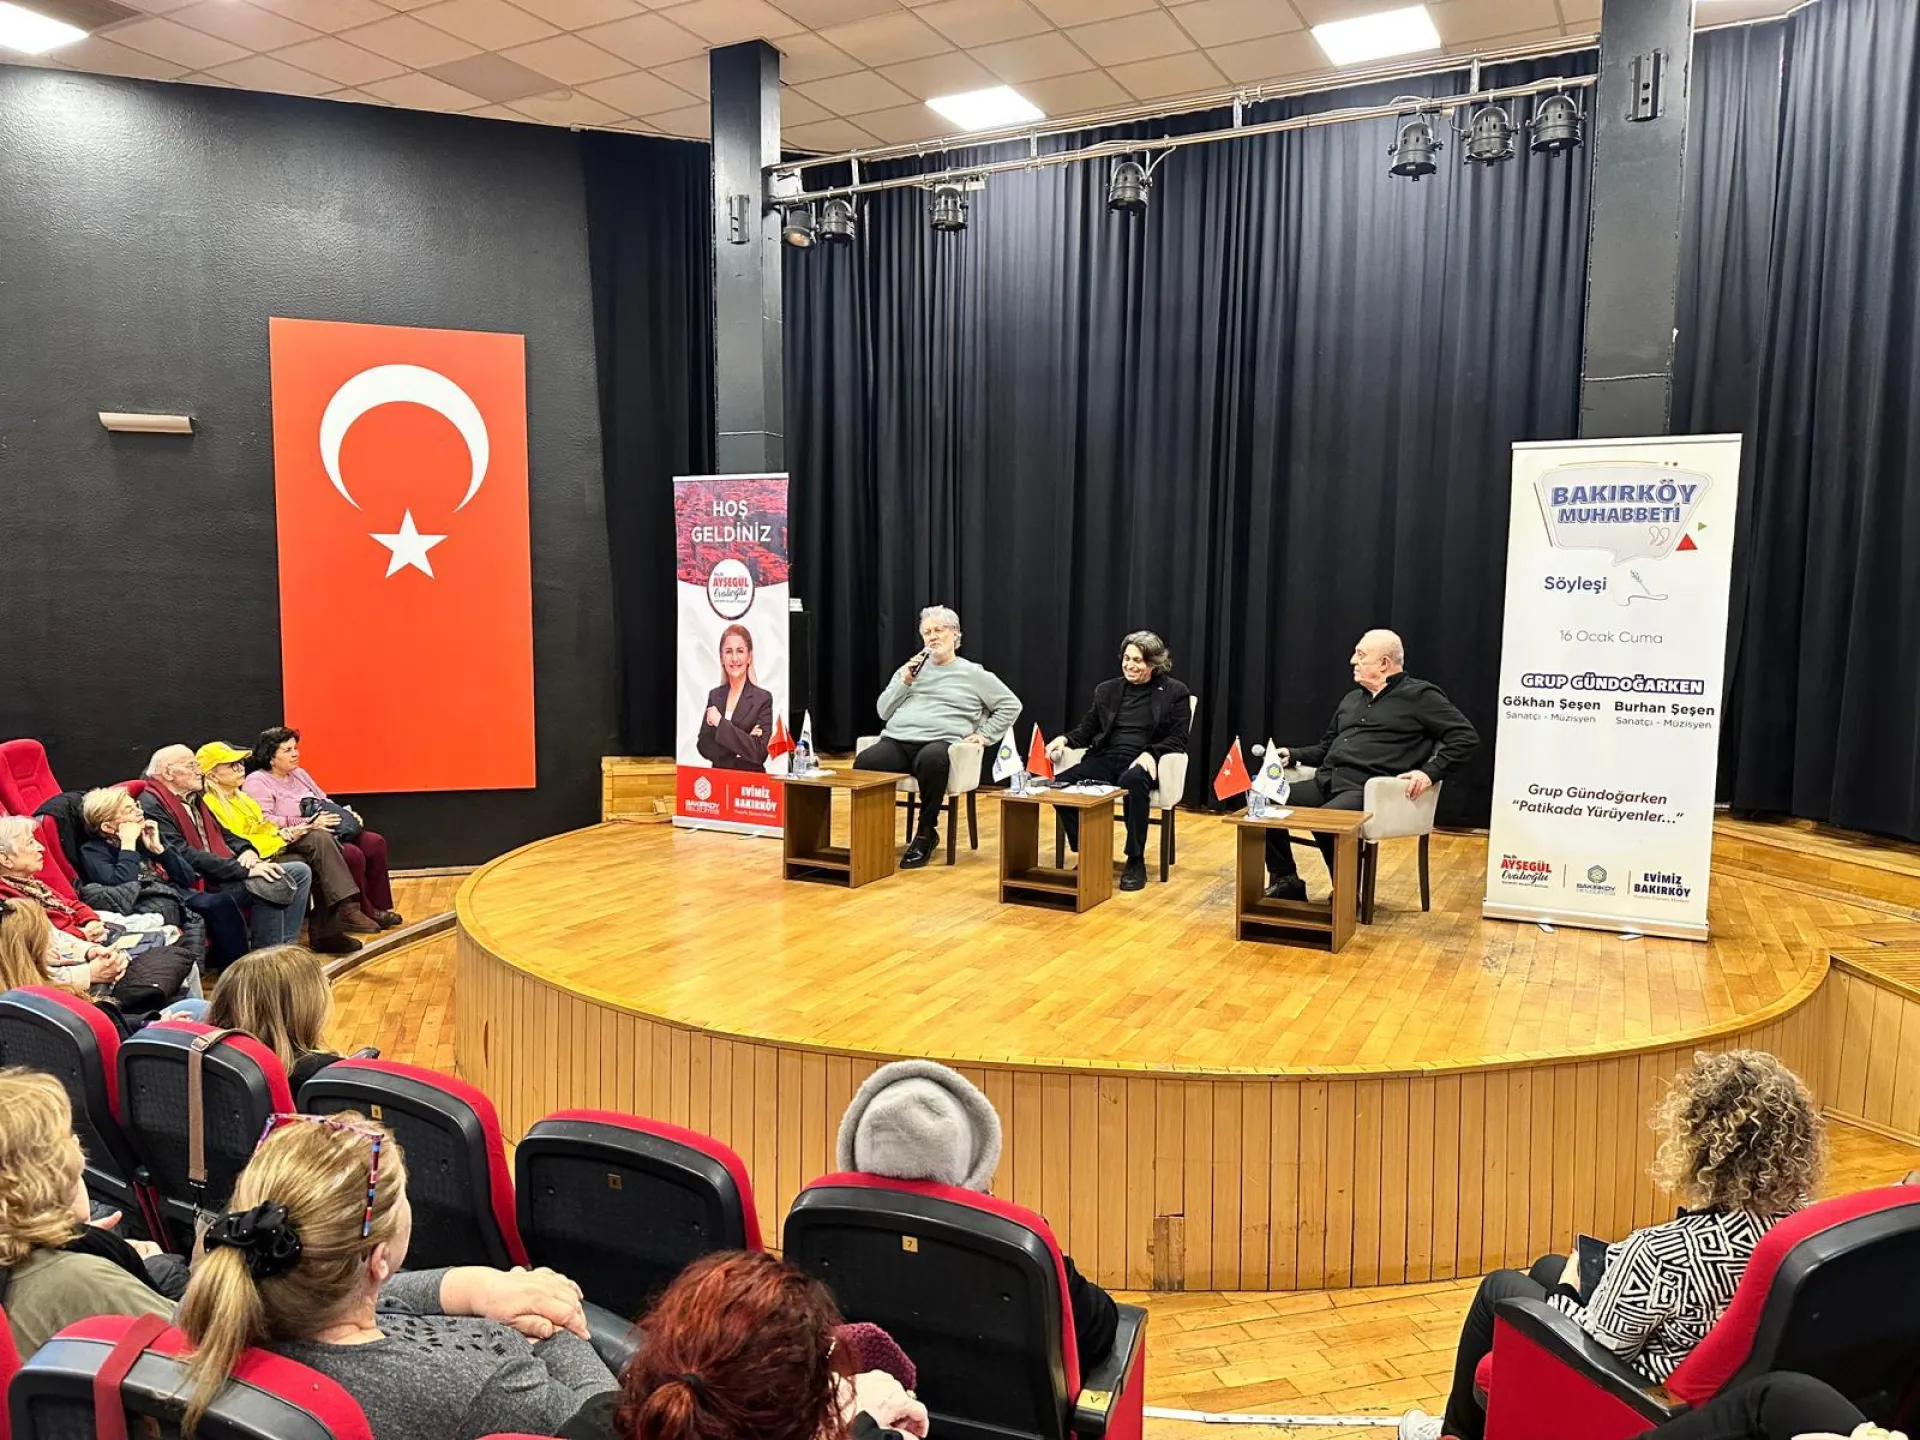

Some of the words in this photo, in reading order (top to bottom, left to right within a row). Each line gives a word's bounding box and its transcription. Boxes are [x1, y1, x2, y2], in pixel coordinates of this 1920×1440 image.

[1551, 478, 1698, 506] BAKIRKÖY
[712, 500, 749, 519] HOŞ
[1557, 502, 1681, 524] MUHABBETİ
[691, 521, 771, 543] GELDİNİZ
[1544, 576, 1607, 595] Söyleşi
[1560, 630, 1573, 642] 16
[1576, 630, 1615, 643] Ocak
[1619, 631, 1663, 645] Cuma
[1521, 673, 1568, 689] GRUP
[1571, 672, 1704, 694] GÜNDOĞARKEN
[1503, 695, 1555, 708] Gökhan
[1559, 698, 1601, 711] Şeşen
[1614, 701, 1666, 714] Burhan
[1671, 703, 1715, 717] Şeşen
[1528, 784, 1563, 799] Grup
[1566, 786, 1667, 805] Gündoğarken
[1512, 799, 1583, 816] “Patikada
[1643, 871, 1682, 885] EVİMİZ
[1634, 883, 1691, 898] BAKIRKÖY
